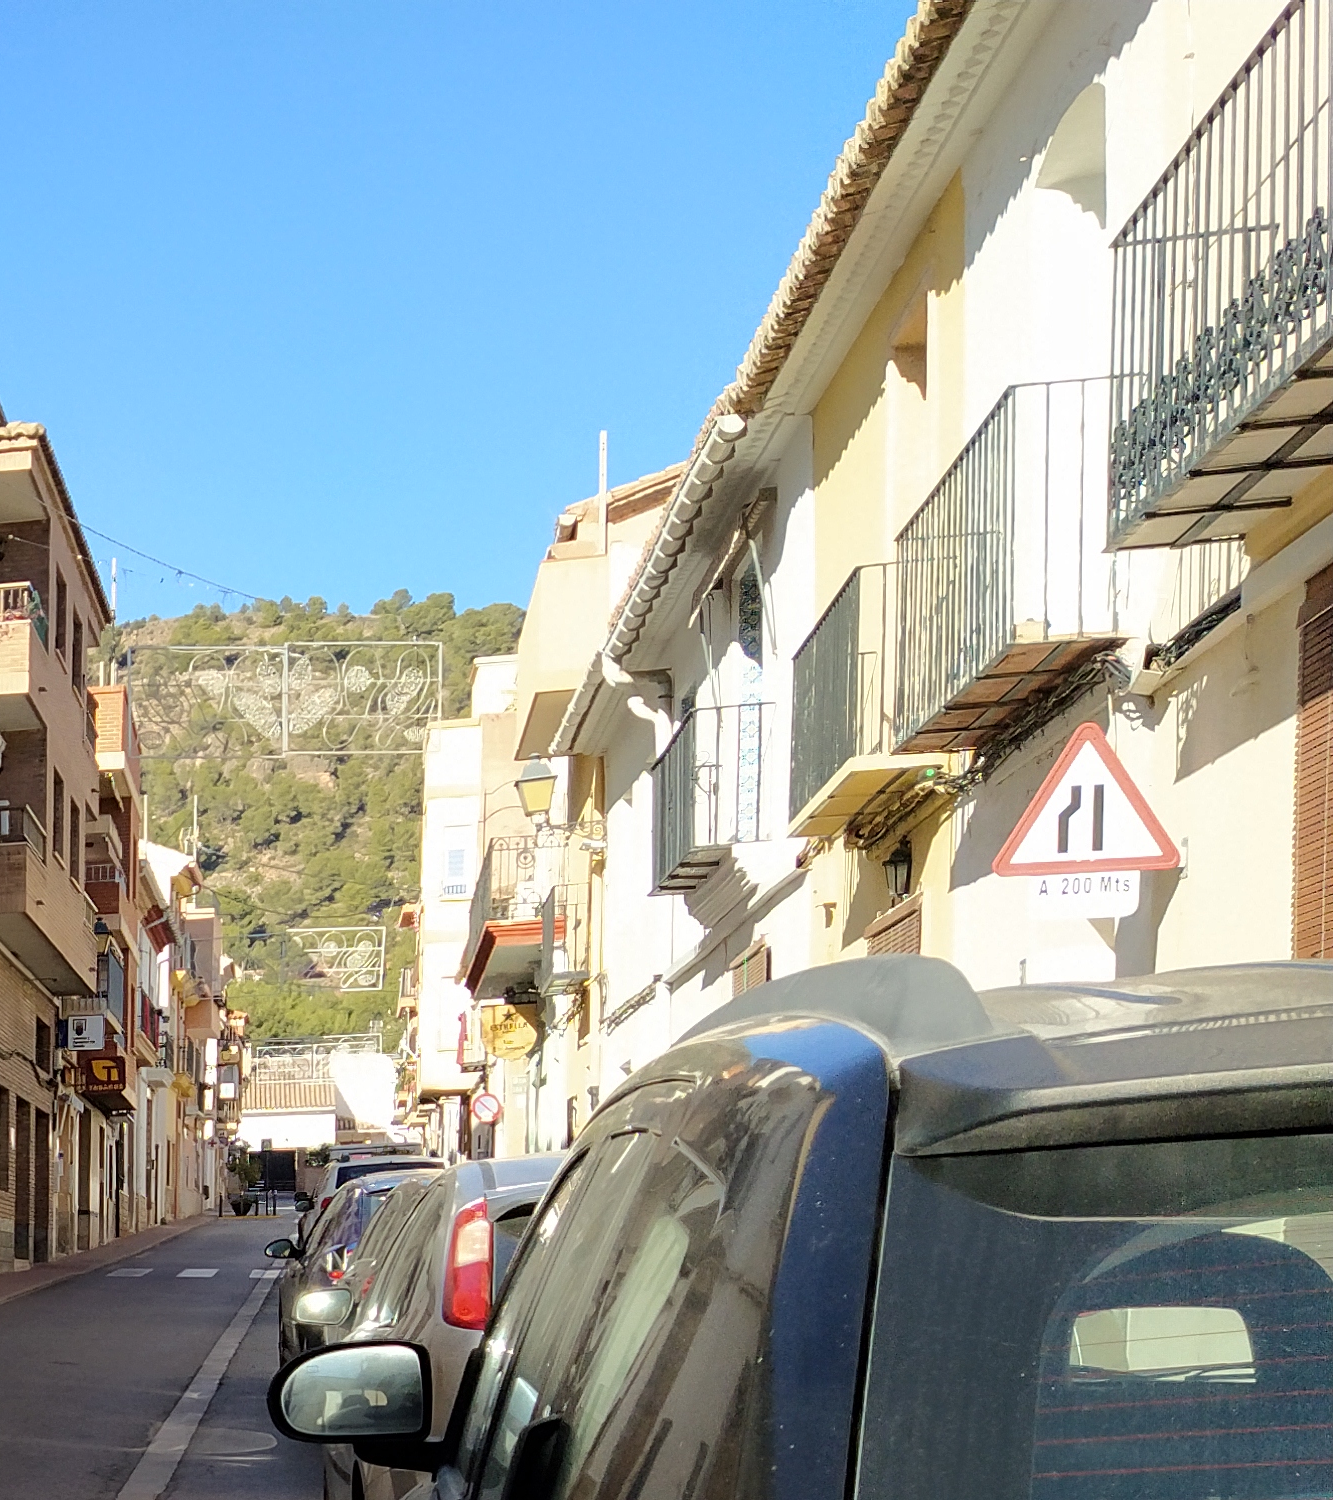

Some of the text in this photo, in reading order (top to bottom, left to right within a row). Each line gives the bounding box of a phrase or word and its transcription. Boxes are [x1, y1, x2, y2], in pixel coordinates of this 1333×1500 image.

[1038, 876, 1131, 896] A 200 Mts
